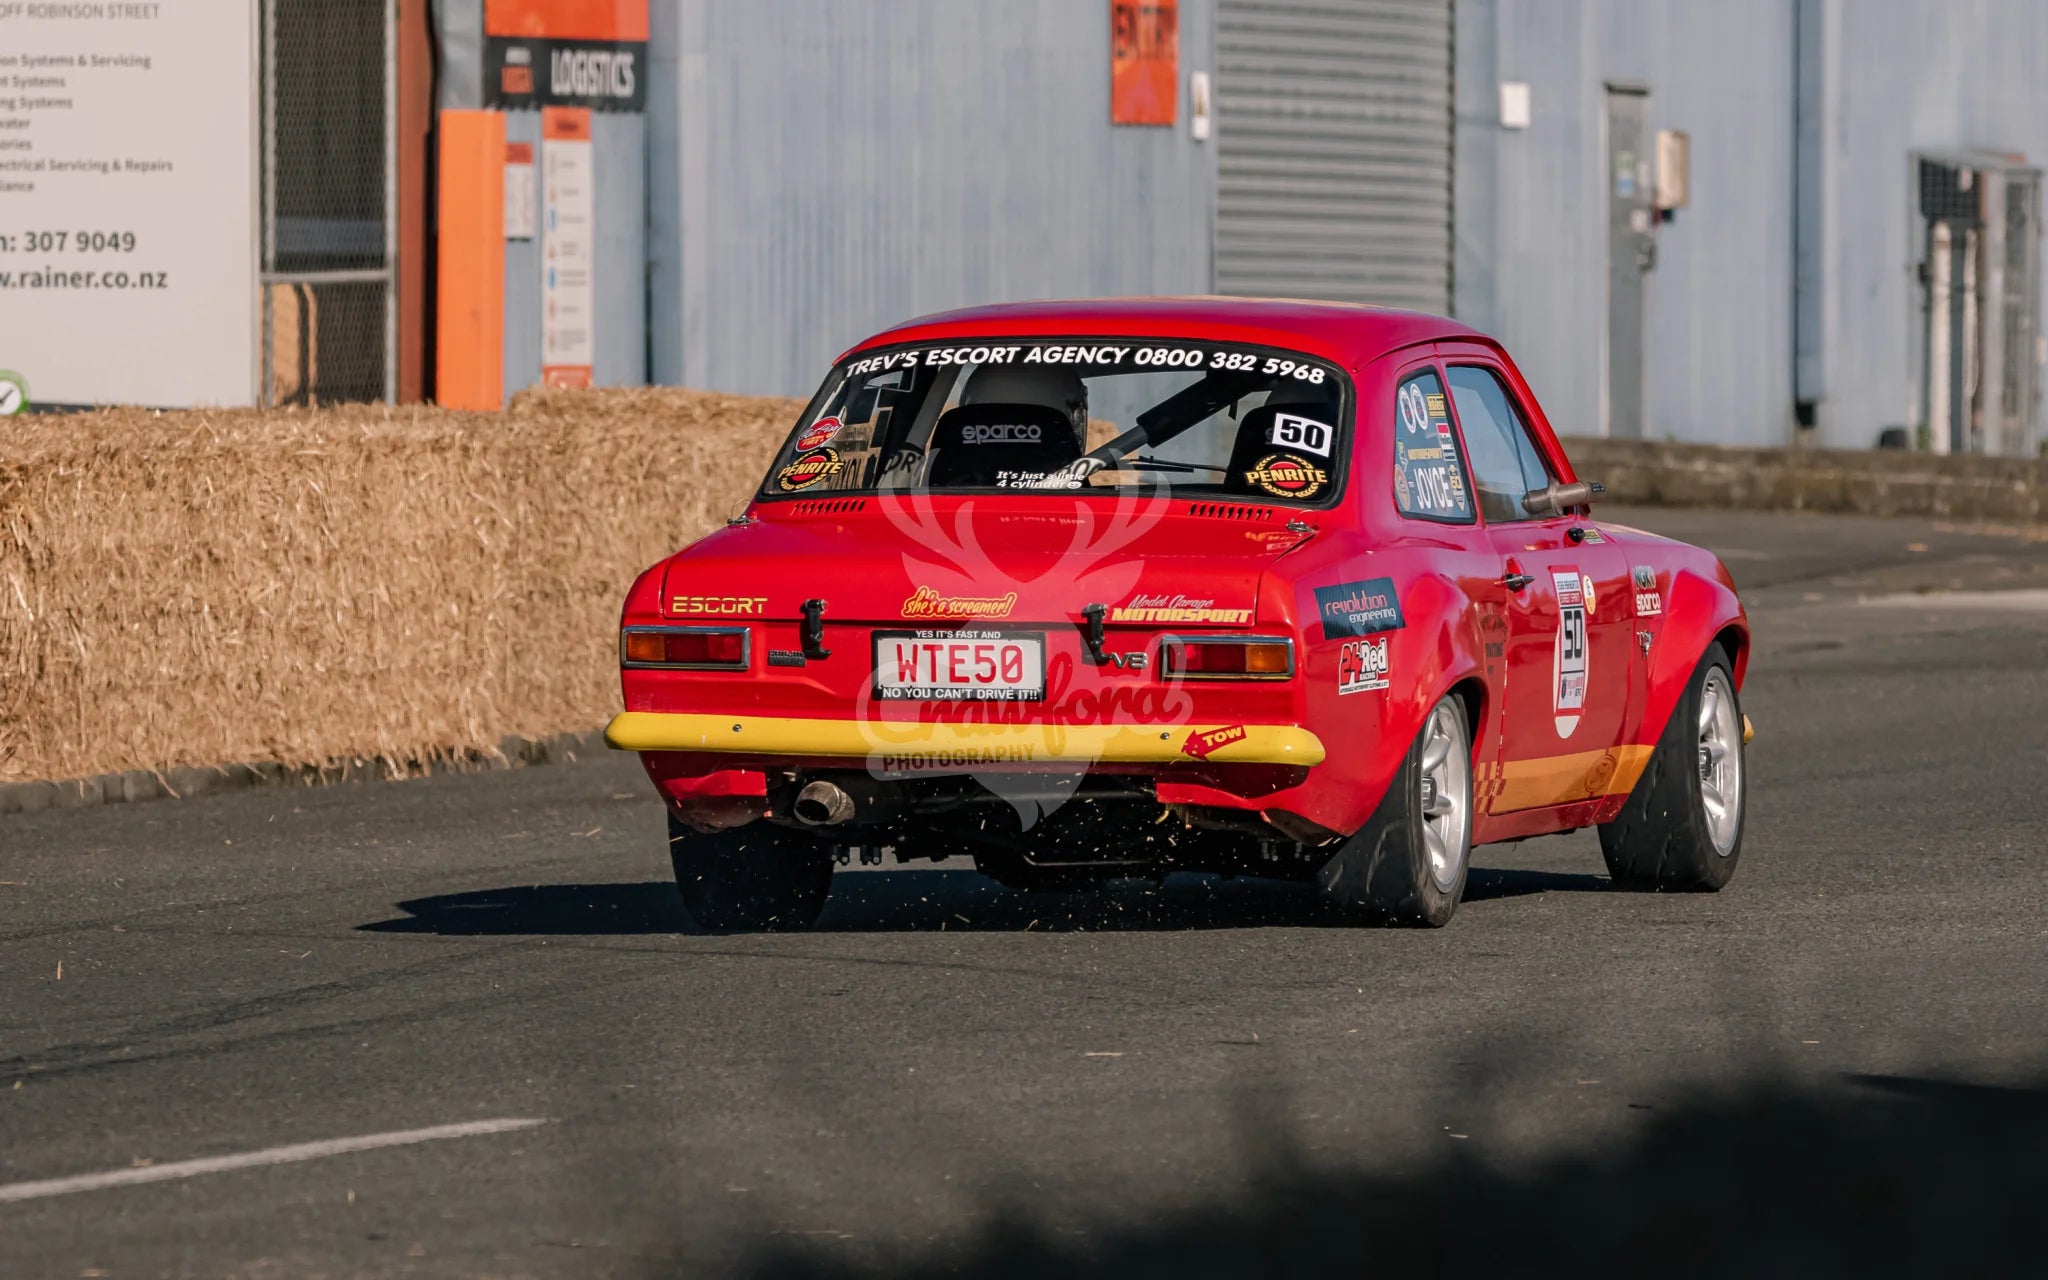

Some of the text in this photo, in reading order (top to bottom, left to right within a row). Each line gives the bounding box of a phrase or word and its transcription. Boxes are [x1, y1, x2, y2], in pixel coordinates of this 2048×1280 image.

[28, 4, 102, 18] ROBINSON
[107, 4, 159, 19] STREET
[21, 54, 74, 68] Systems
[78, 55, 87, 66] &
[91, 54, 151, 69] Servicing
[550, 50, 635, 96] LOGISTICS
[12, 75, 65, 89] Systems
[20, 96, 73, 110] Systems
[50, 159, 109, 174] Servicing
[113, 160, 121, 171] &
[125, 159, 173, 173] Repairs
[24, 231, 68, 253] 307
[76, 231, 136, 253] 9049
[846, 346, 1326, 384] TREV'S ESCORT AGENCY 0800 382 5968
[962, 424, 1042, 445] sparco
[1279, 418, 1326, 450] 50
[777, 462, 844, 479] PENRITE
[1019, 471, 1045, 481] just
[1057, 472, 1085, 481] little
[1245, 468, 1328, 484] PENRITE
[996, 480, 1065, 489] 4 cylinder
[1414, 467, 1453, 509] JOYCE
[672, 596, 768, 614] ESCORT
[949, 596, 1013, 613] screamer!
[1127, 594, 1214, 609] Model Garage
[1325, 590, 1388, 616] revolution
[1637, 592, 1661, 616] sparco
[1112, 607, 1253, 623] MOTORSPORT
[1349, 608, 1397, 625] engineering
[916, 630, 1001, 639] YES IT'S FAST AND
[1564, 610, 1583, 660] 50
[896, 643, 1023, 683] WTE50
[1112, 652, 1148, 669] V8
[883, 688, 901, 698] NO
[906, 688, 931, 699] YOU
[935, 688, 973, 699] CAN'T
[977, 689, 1014, 699] DRIVE
[1202, 727, 1243, 747] TOW
